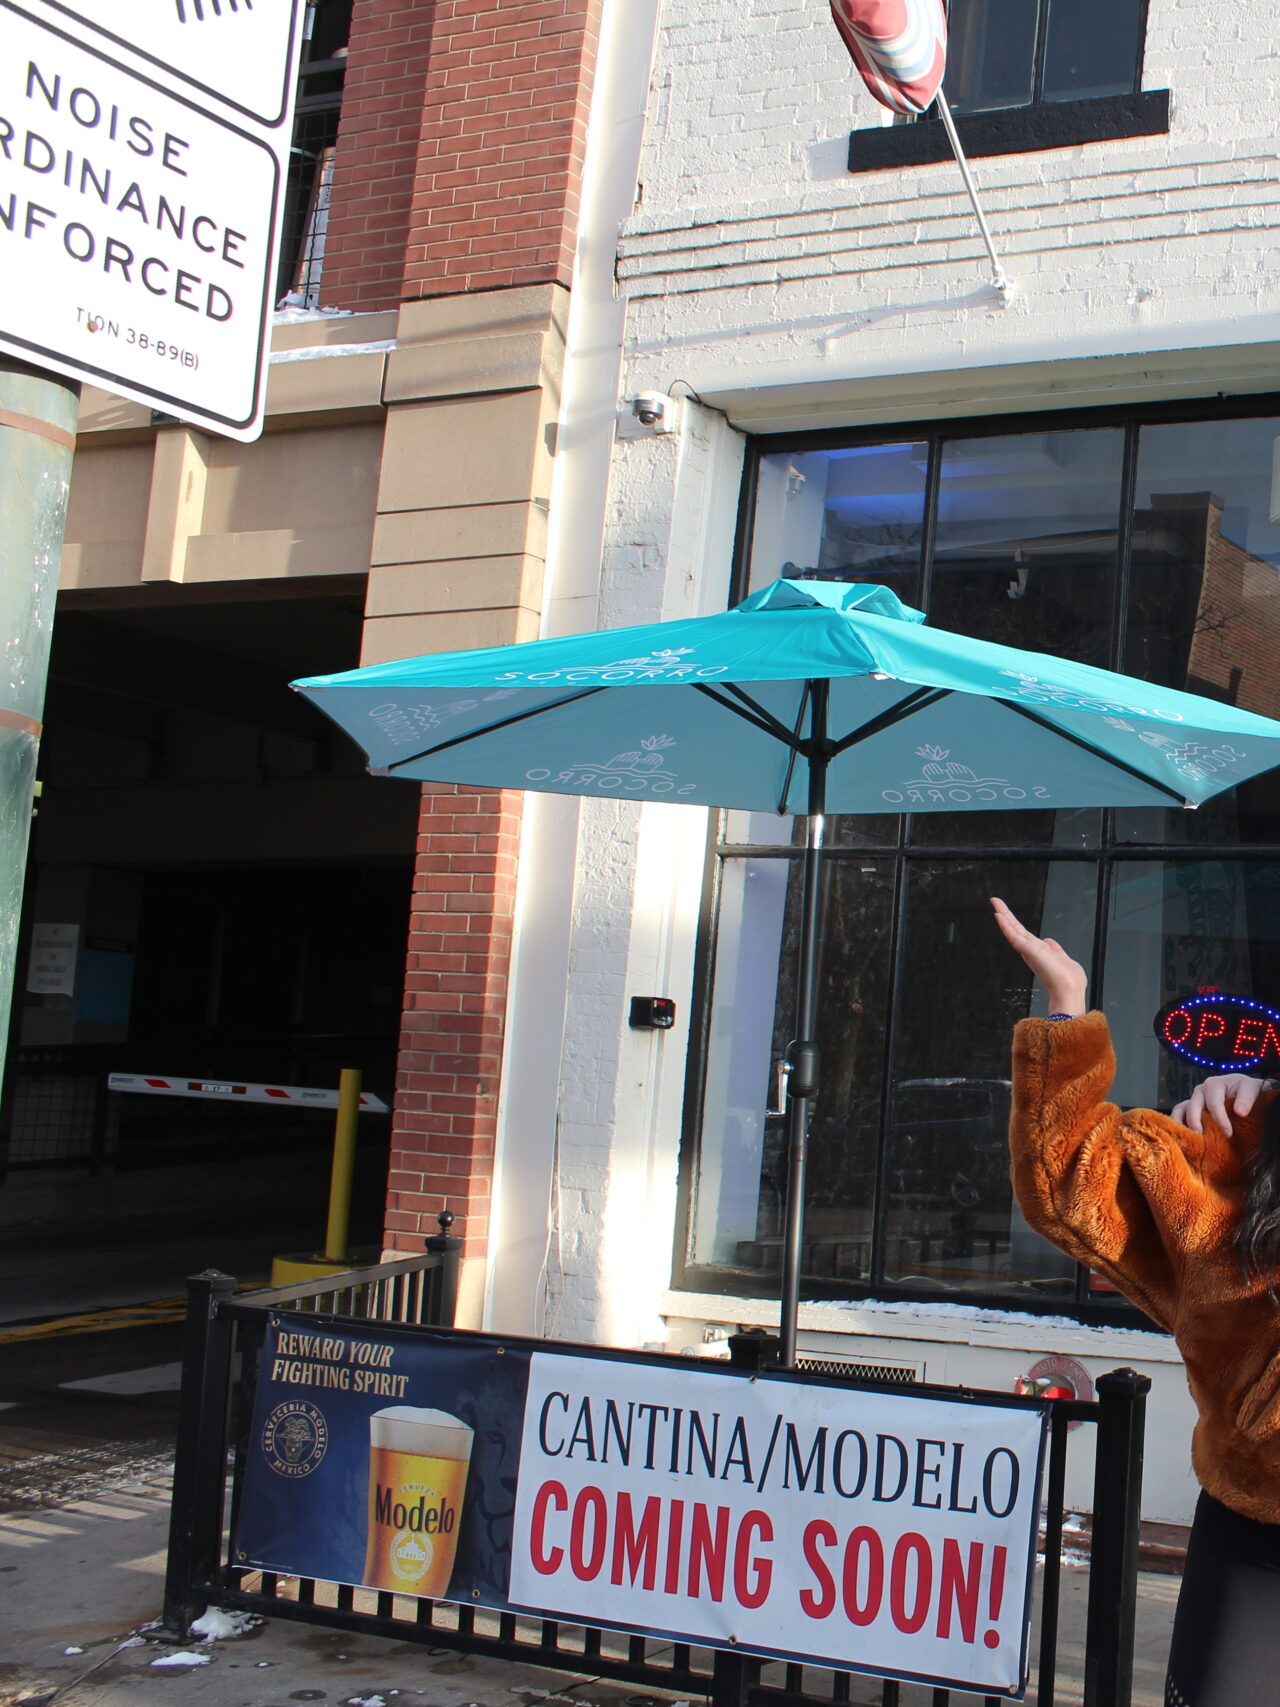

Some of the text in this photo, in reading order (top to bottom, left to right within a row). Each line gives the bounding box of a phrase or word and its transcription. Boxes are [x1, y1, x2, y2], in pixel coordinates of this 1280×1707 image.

[26, 60, 190, 177] NOISE
[126, 328, 199, 371] 38-89(B)
[494, 665, 730, 682] SOCORRO
[991, 686, 1184, 722] SOCORRO
[276, 1332, 395, 1368] REWARD YOUR
[271, 1359, 409, 1398] FIGHTING SPIRIT
[538, 1391, 1020, 1518] CANTINA/MODELO
[375, 1483, 455, 1534] Modelo
[530, 1479, 1008, 1650] COMING SOON!
